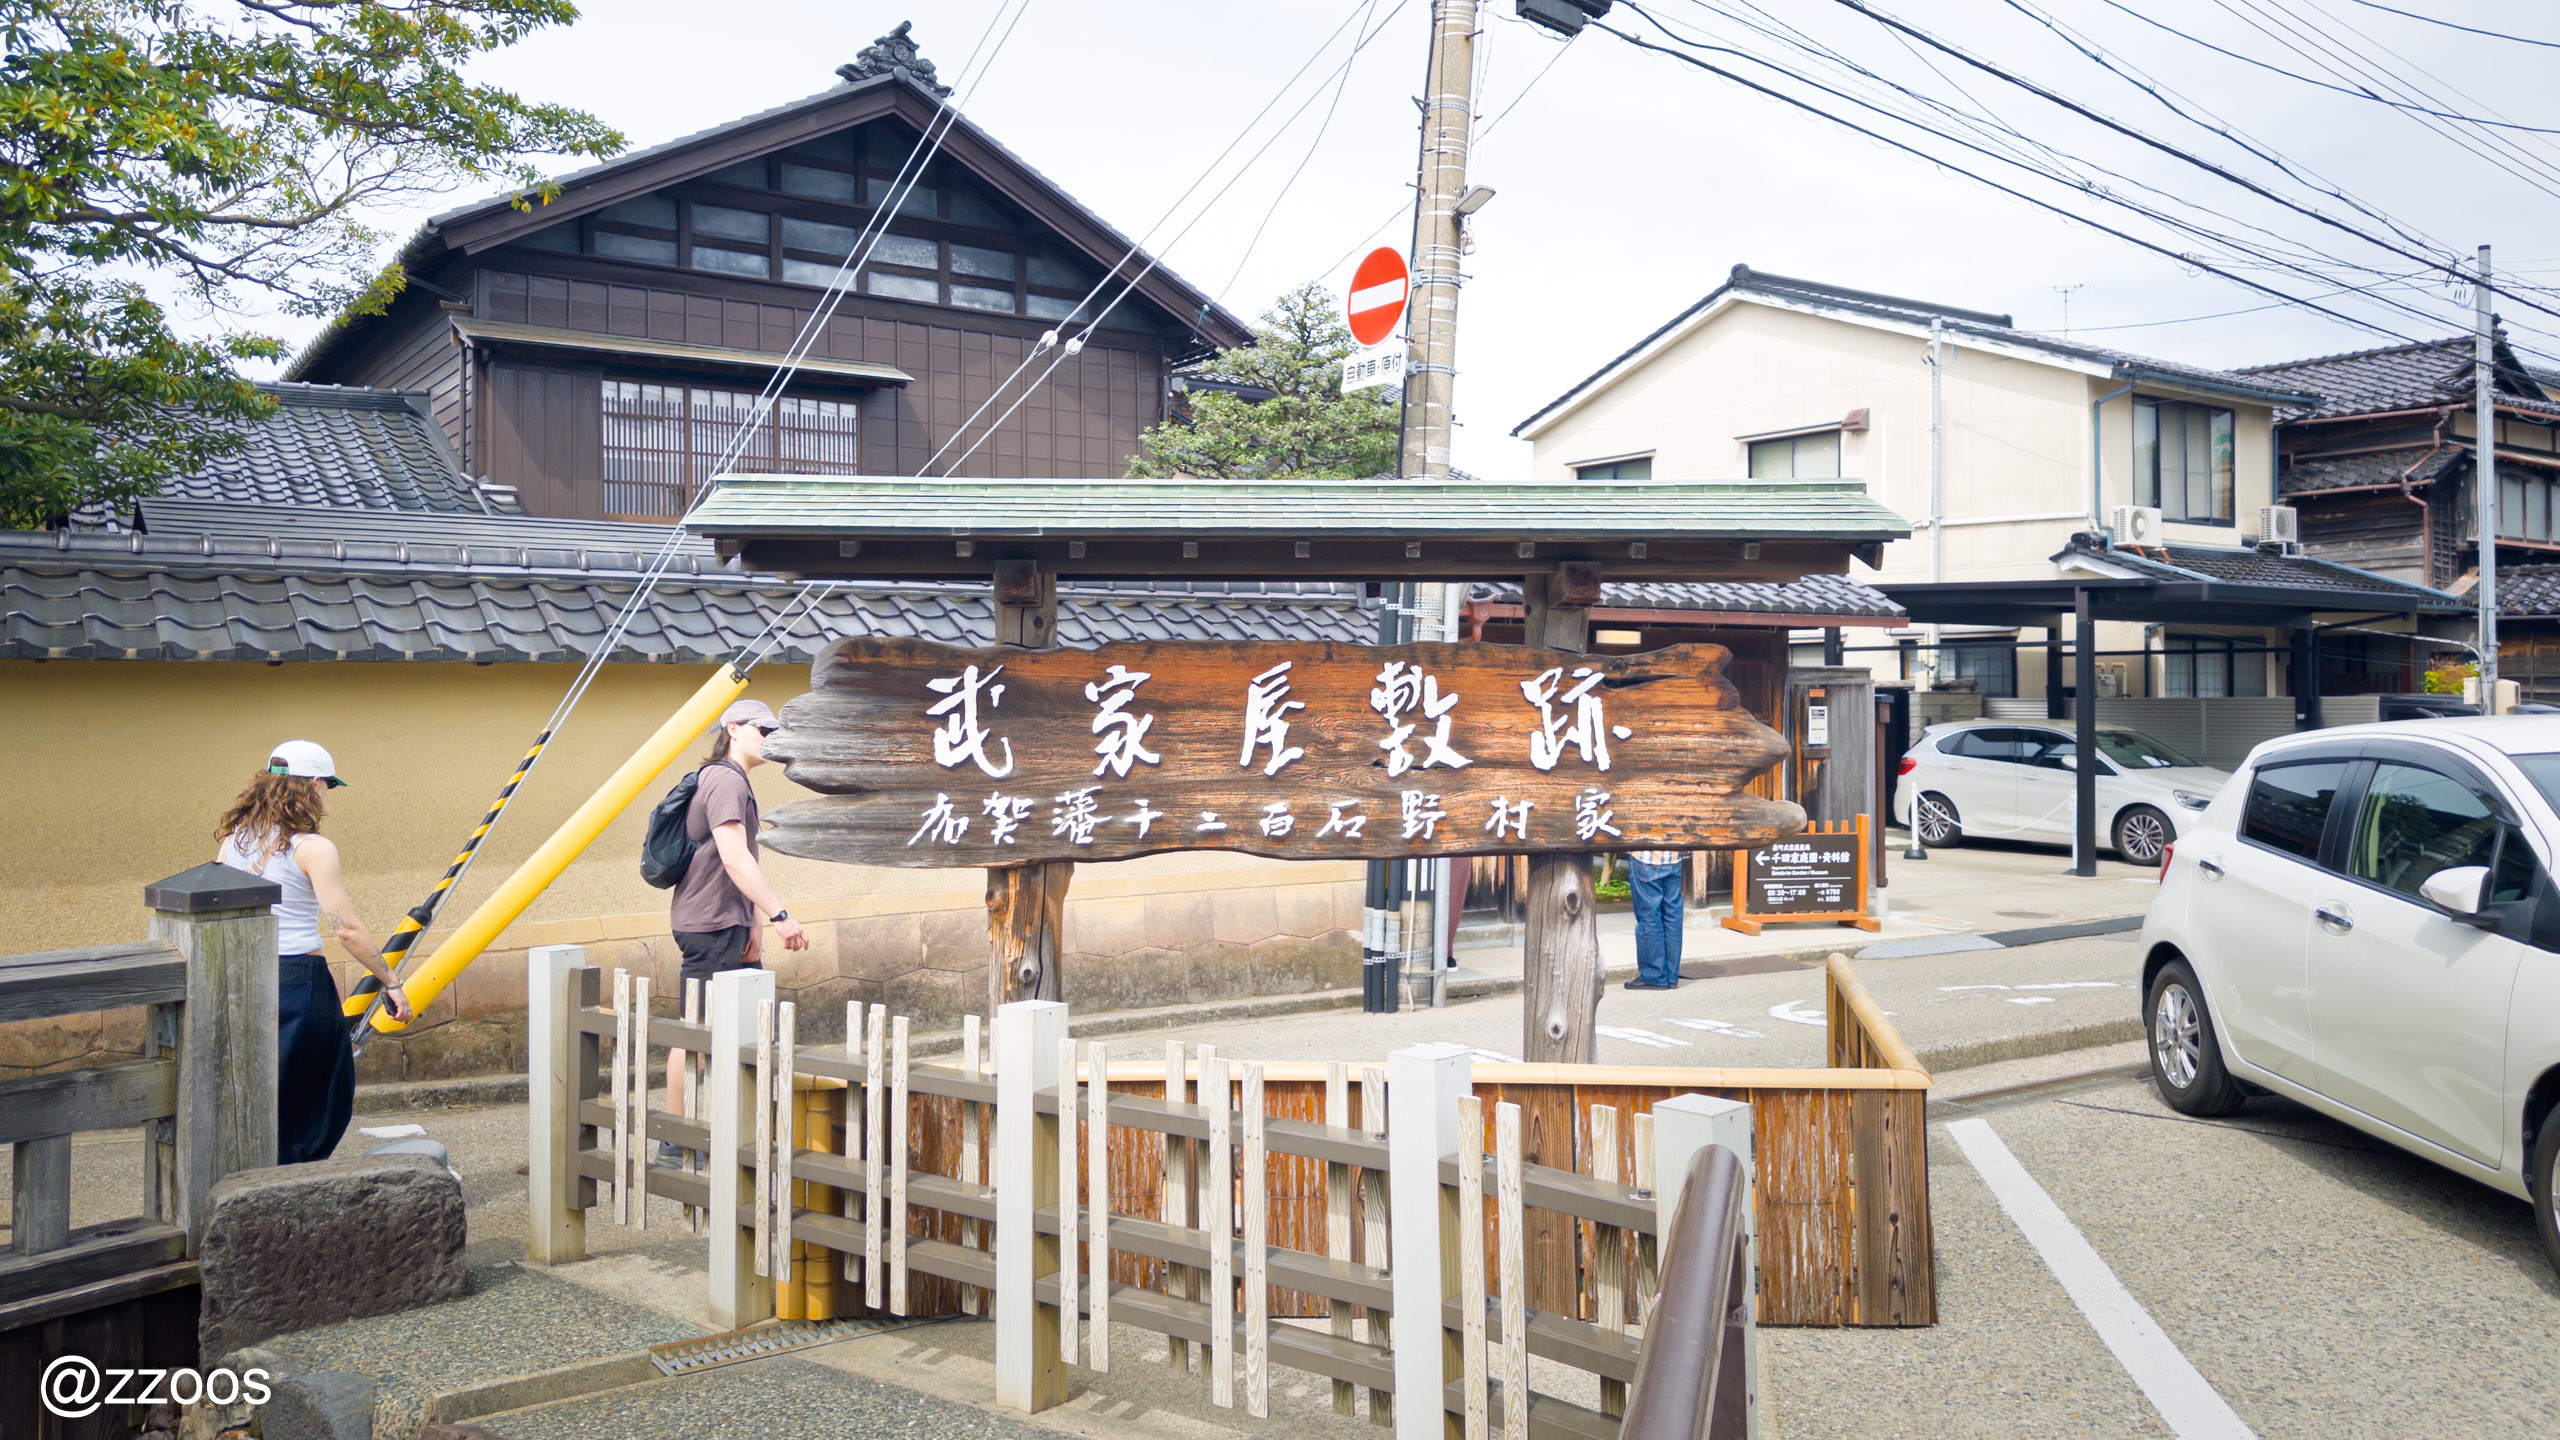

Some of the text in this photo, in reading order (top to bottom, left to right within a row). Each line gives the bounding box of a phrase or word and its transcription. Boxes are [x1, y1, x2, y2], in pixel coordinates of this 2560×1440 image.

[926, 661, 1632, 778] 武家屋敷跡
